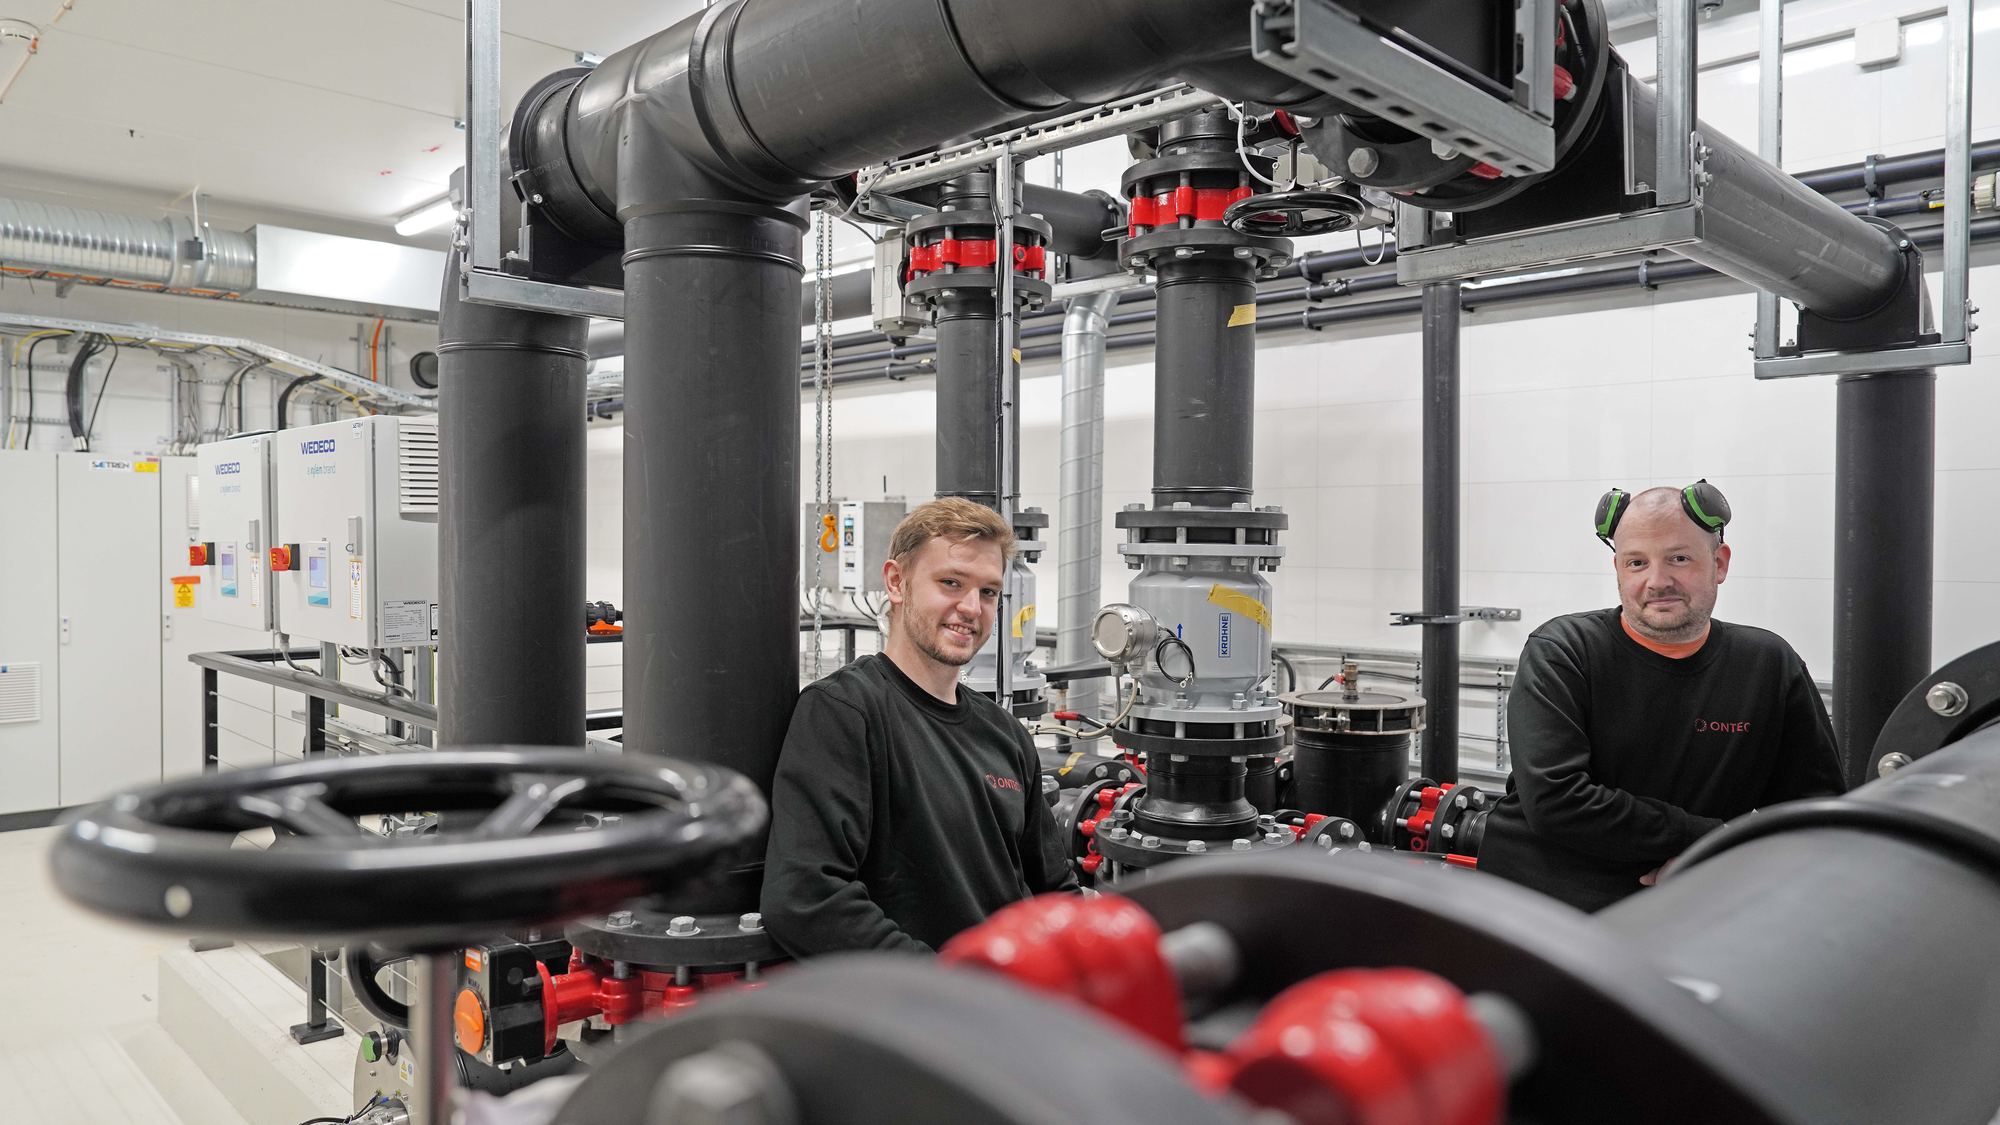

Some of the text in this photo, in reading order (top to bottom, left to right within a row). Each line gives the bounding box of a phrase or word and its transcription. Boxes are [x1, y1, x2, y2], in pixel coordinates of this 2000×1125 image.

[301, 439, 336, 455] WEDECO
[215, 462, 240, 475] WEDECO
[1221, 615, 1229, 655] KROHNE
[1710, 721, 1750, 733] ONTEC
